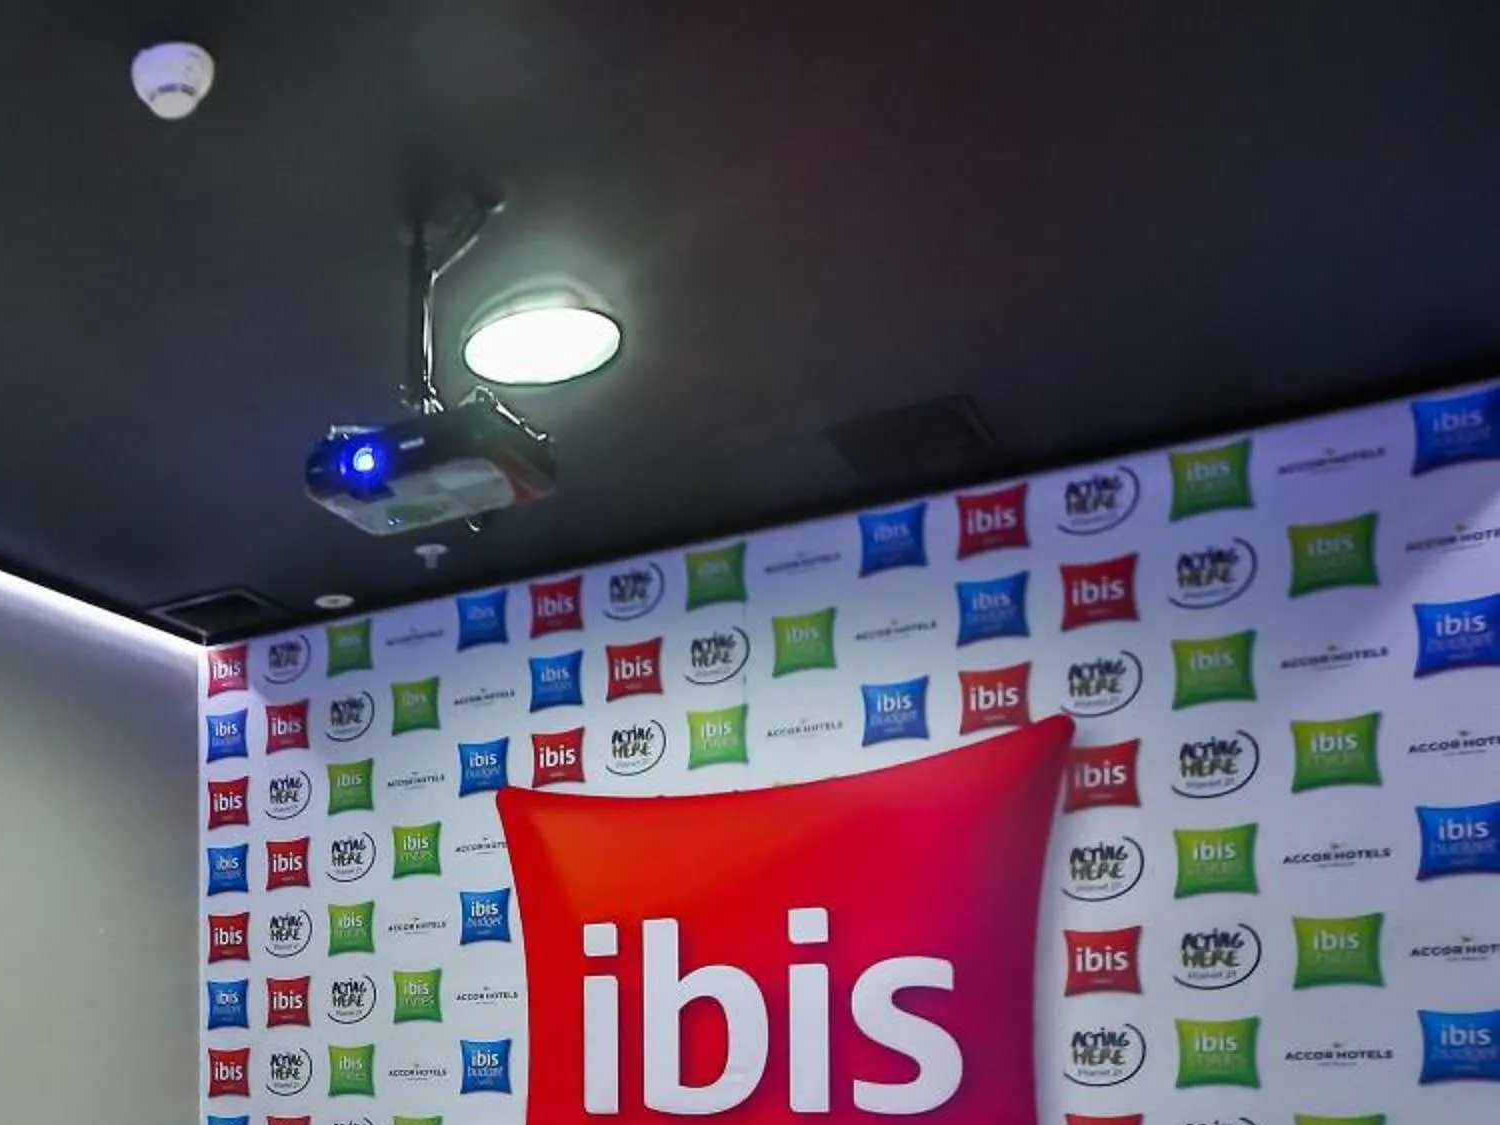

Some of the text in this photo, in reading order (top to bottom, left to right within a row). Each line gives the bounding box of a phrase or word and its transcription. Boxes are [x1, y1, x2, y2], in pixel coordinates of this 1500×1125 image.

[1432, 409, 1483, 434] ibis
[1187, 459, 1231, 480] ibis
[967, 506, 1017, 534] ibis
[874, 523, 910, 542] ibis
[1307, 535, 1355, 557] ibis
[972, 590, 1012, 611] ibis
[1071, 575, 1125, 607] ibis
[535, 590, 574, 617] ibis
[1435, 612, 1487, 637] ibis
[786, 625, 818, 644] ibis
[613, 655, 654, 680] ibis
[1189, 647, 1234, 670] ibis
[213, 660, 241, 678] ibis
[540, 665, 569, 682] ibis
[877, 692, 912, 711] ibis
[970, 683, 1020, 711] ibis
[215, 721, 238, 737] ibis
[272, 717, 300, 734] ibis
[701, 720, 732, 738] ibis
[701, 721, 732, 738] ibis
[1310, 731, 1357, 753] ibis
[470, 752, 497, 767] ibis
[539, 746, 577, 767] ibis
[338, 773, 362, 786] ibis
[1074, 762, 1127, 788] ibis
[214, 794, 242, 811] ibis
[1438, 817, 1490, 841] ibis
[403, 834, 429, 850] ibis
[1192, 839, 1236, 860] ibis
[215, 856, 238, 870] ibis
[273, 853, 302, 871] ibis
[471, 900, 499, 916] ibis
[338, 915, 362, 928] ibis
[214, 927, 243, 945] ibis
[1312, 929, 1360, 950] ibis
[1076, 949, 1127, 973] ibis
[404, 982, 428, 995] ibis
[216, 992, 238, 1005] ibis
[273, 991, 302, 1009] ibis
[584, 908, 963, 1116] ibis
[1195, 1032, 1238, 1052] ibis
[1439, 1024, 1491, 1047] ibis
[339, 1056, 362, 1070] ibis
[471, 1048, 499, 1066] ibis
[215, 1062, 243, 1080] ibis
